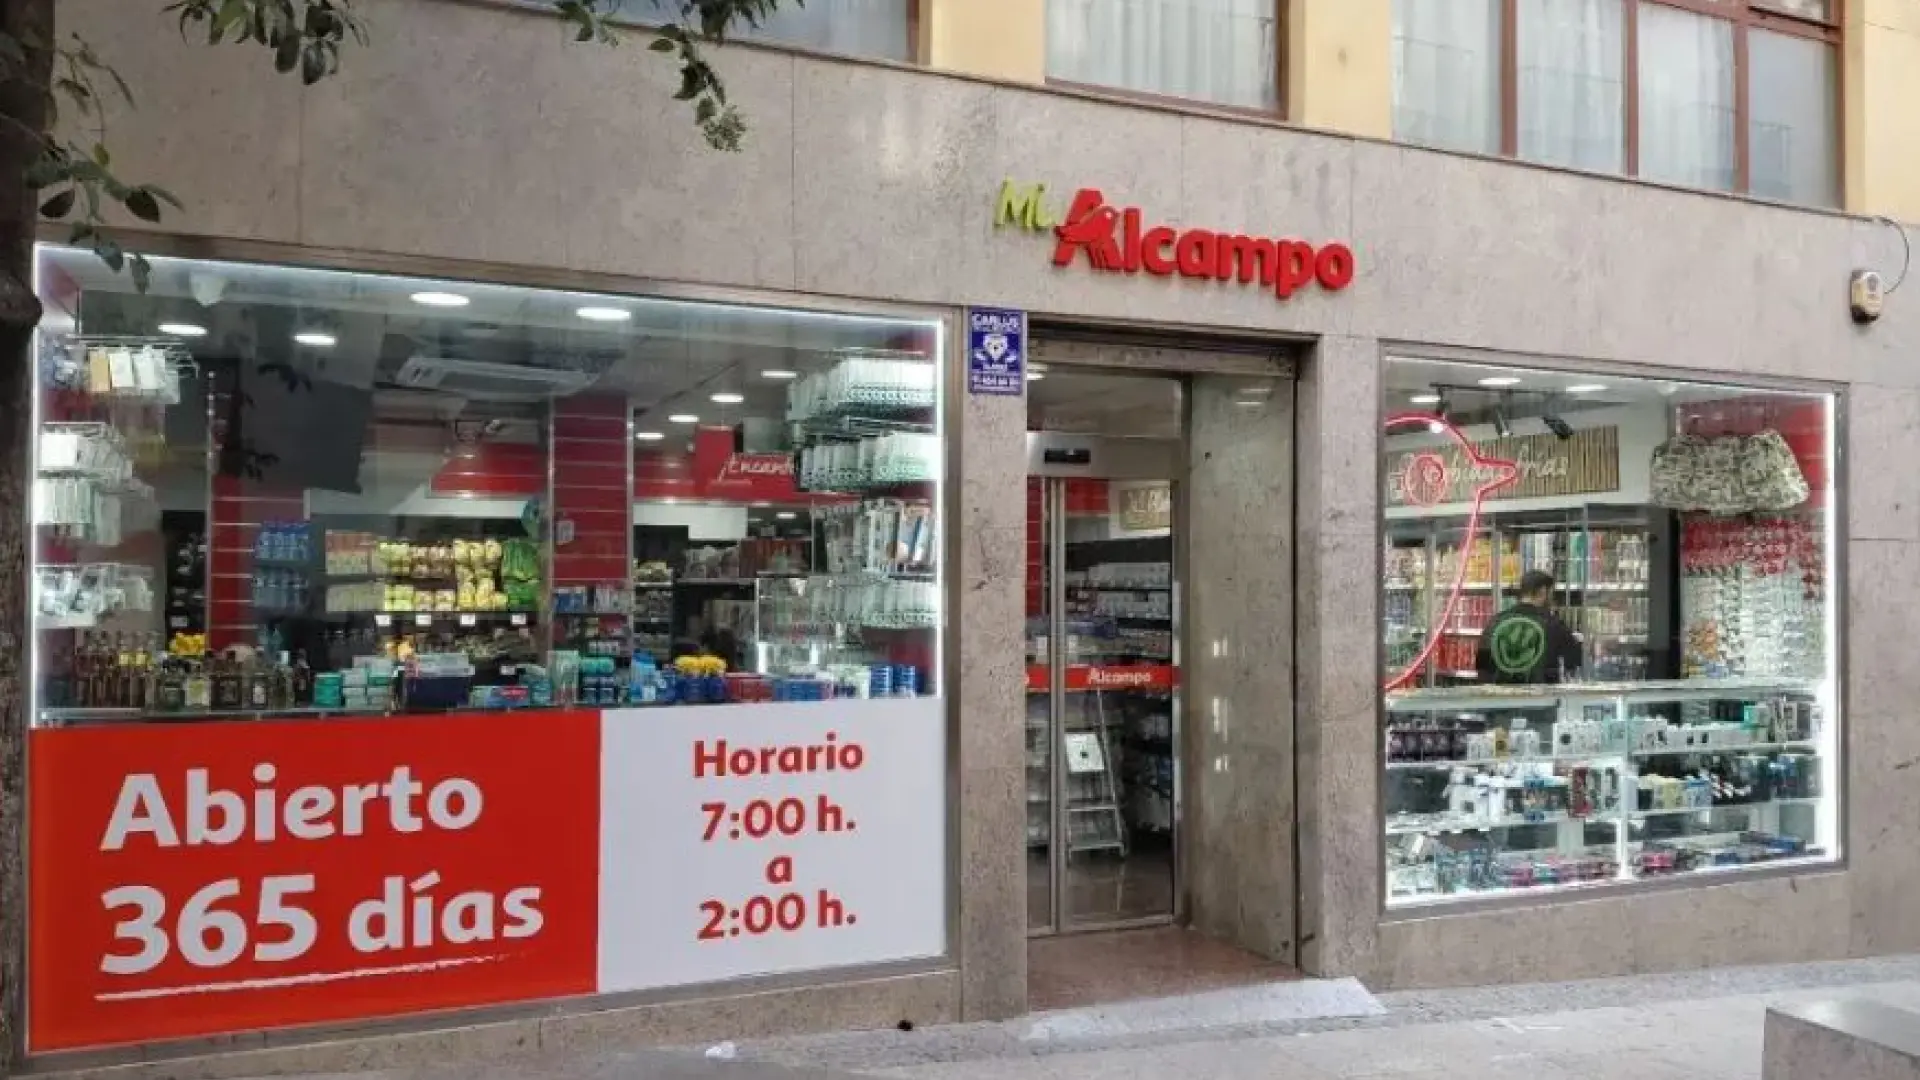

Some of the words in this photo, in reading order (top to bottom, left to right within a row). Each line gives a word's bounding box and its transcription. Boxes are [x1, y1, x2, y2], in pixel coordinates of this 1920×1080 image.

[994, 180, 1056, 231] Mi
[1053, 187, 1354, 300] Alcampo
[1087, 667, 1152, 685] Alcampo
[693, 731, 864, 779] Horario
[100, 762, 483, 850] Abierto
[701, 797, 806, 841] 7:00
[816, 793, 857, 832] h.
[765, 855, 794, 885] a
[101, 873, 319, 974] 365
[347, 870, 544, 952] días
[697, 892, 807, 940] 2:00
[816, 888, 857, 929] h.
